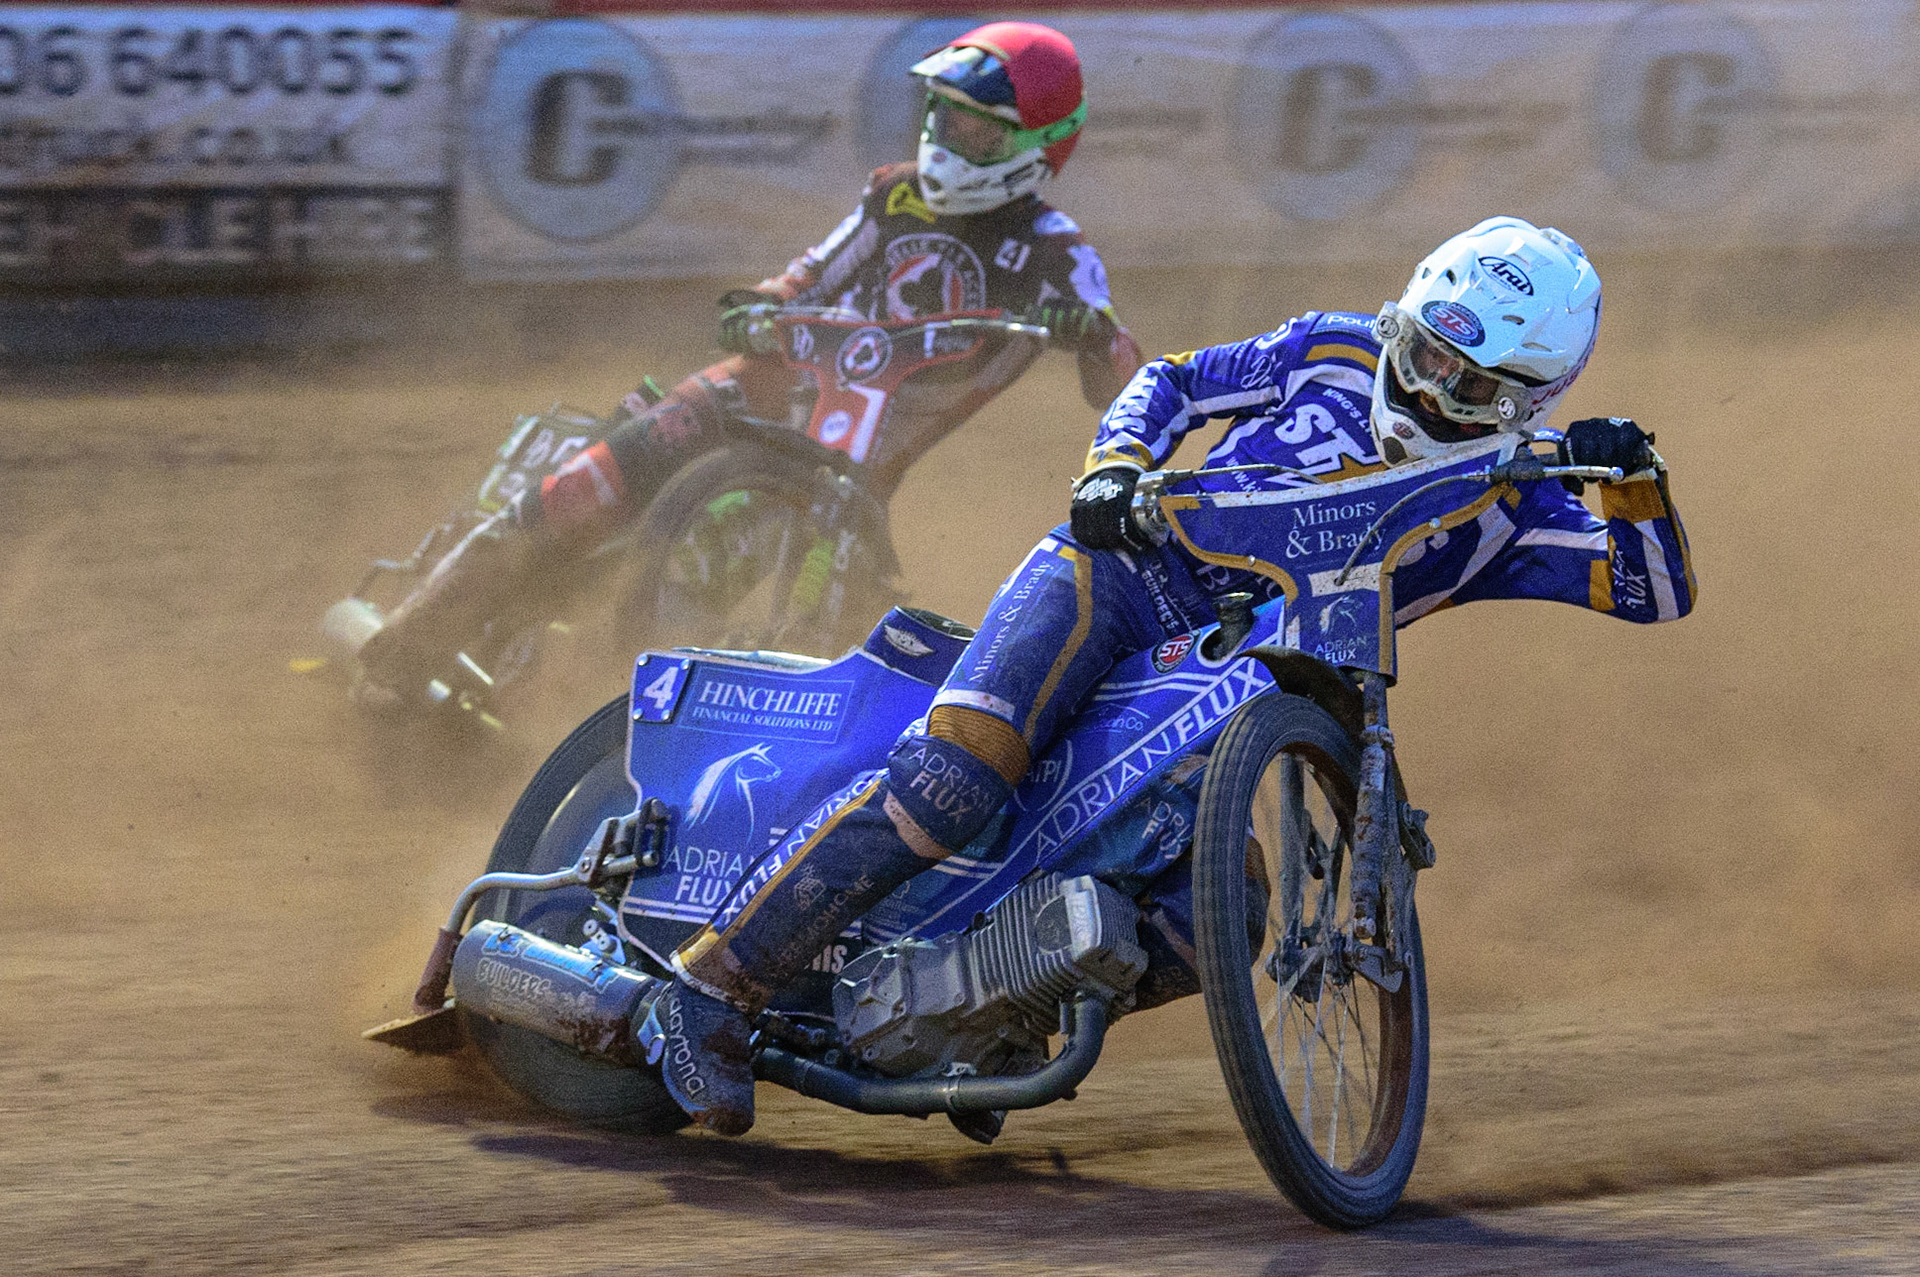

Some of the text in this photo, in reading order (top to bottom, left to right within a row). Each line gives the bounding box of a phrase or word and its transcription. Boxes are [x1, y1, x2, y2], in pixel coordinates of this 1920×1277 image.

[110, 27, 415, 97] 640055
[1491, 262, 1530, 293] Arai
[1327, 314, 1377, 330] poul
[1431, 306, 1476, 336] STS
[1322, 387, 1362, 420] KING'S
[1292, 500, 1377, 529] Minors
[1286, 530, 1313, 559] &
[968, 561, 1055, 682] Minors & Brady
[1159, 639, 1192, 657] STS
[1325, 648, 1356, 664] FLUX
[643, 667, 679, 709] 4
[699, 681, 842, 716] HINCHLIFFE
[692, 706, 833, 732] FINANCIAL SOLUTIONS LTD
[910, 770, 973, 825] FLUX
[662, 845, 755, 878] ADRIA
[669, 998, 706, 1096] daytona
